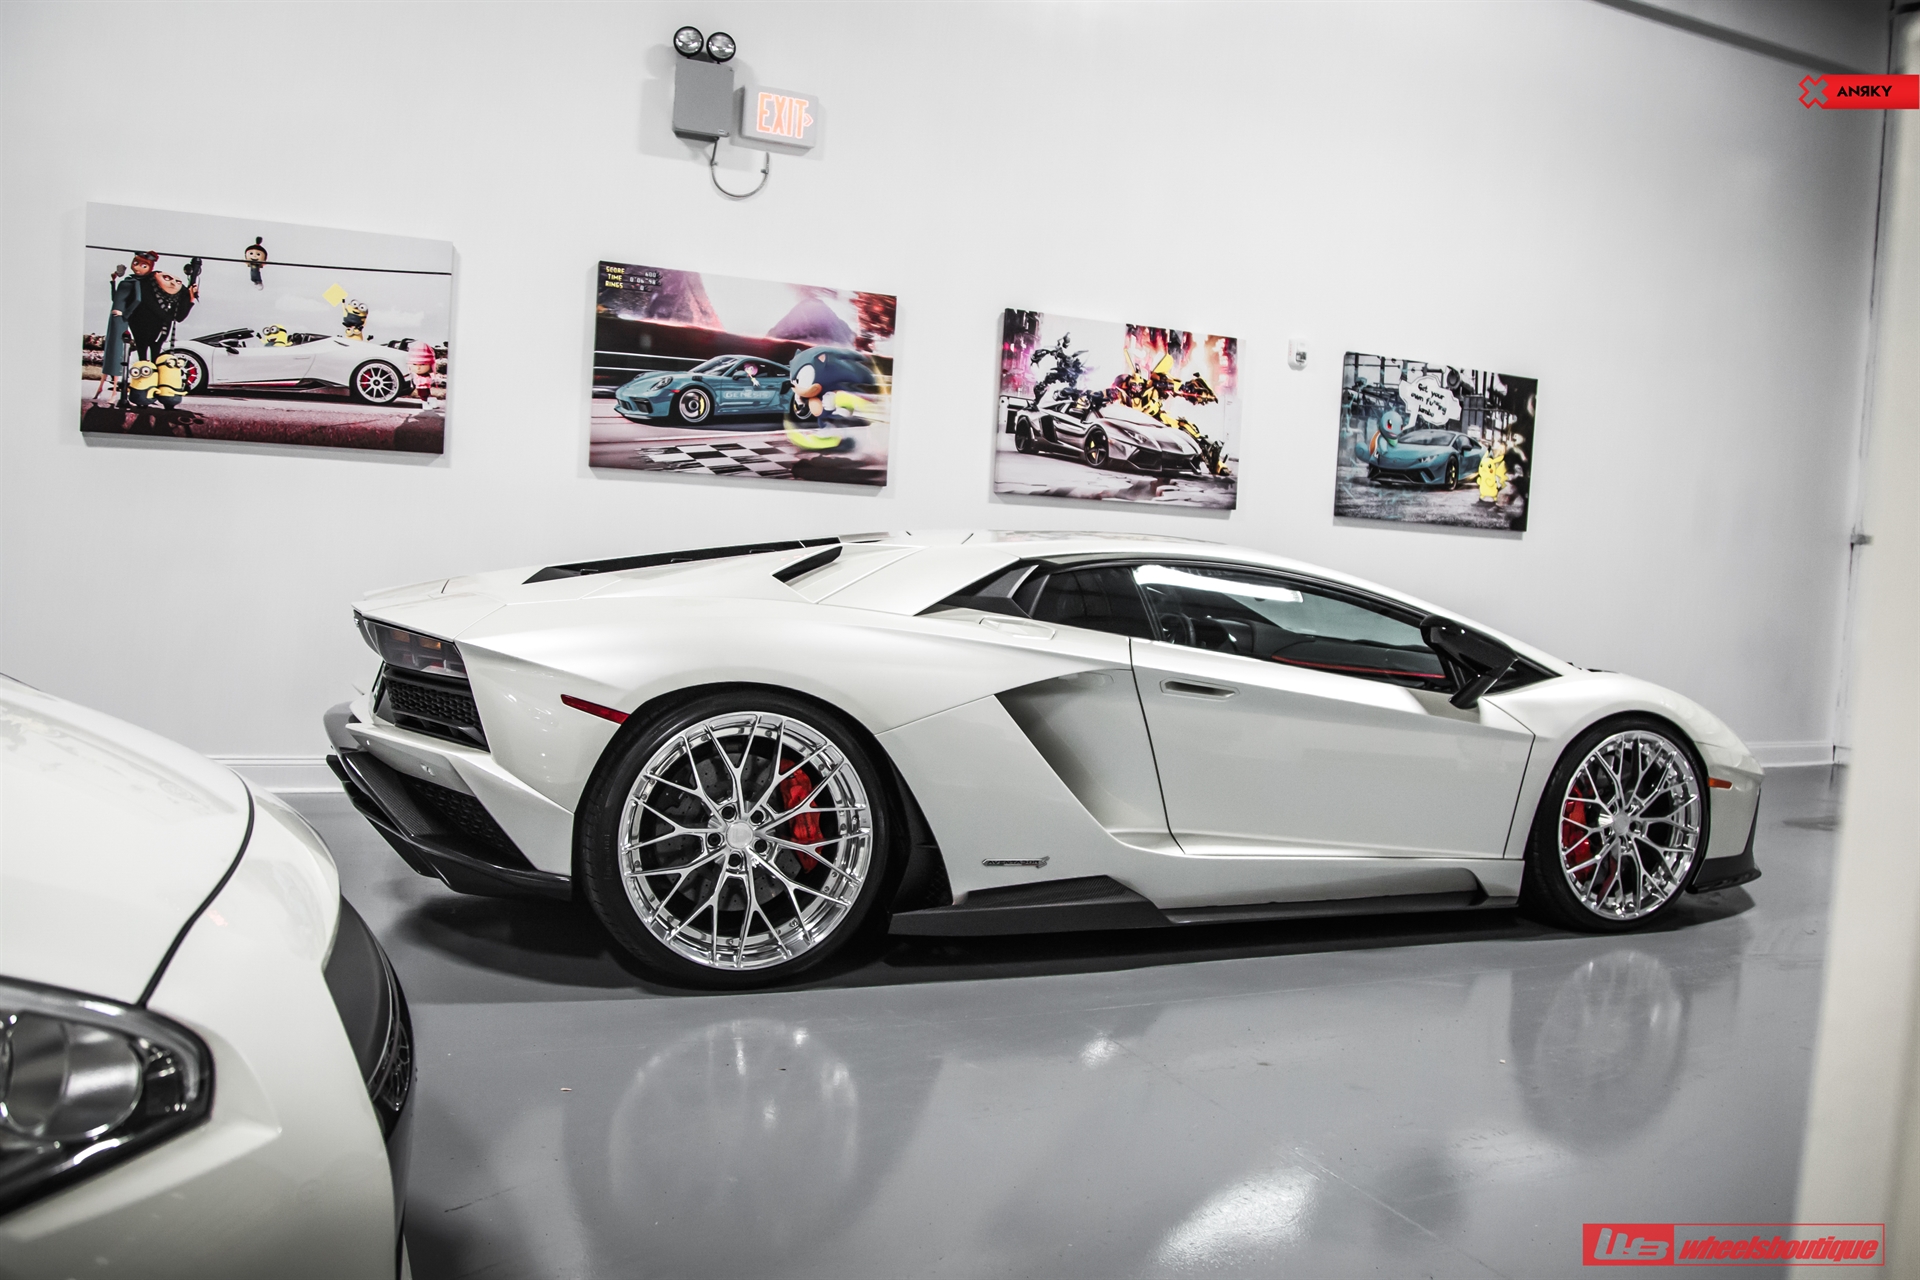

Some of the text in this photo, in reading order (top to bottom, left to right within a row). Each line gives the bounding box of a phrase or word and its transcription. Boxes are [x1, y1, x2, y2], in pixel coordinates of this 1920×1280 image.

[757, 92, 809, 139] EXIT
[605, 266, 625, 275] SCORE
[608, 274, 622, 282] TIME
[605, 281, 623, 289] RINGS
[1411, 392, 1424, 402] own
